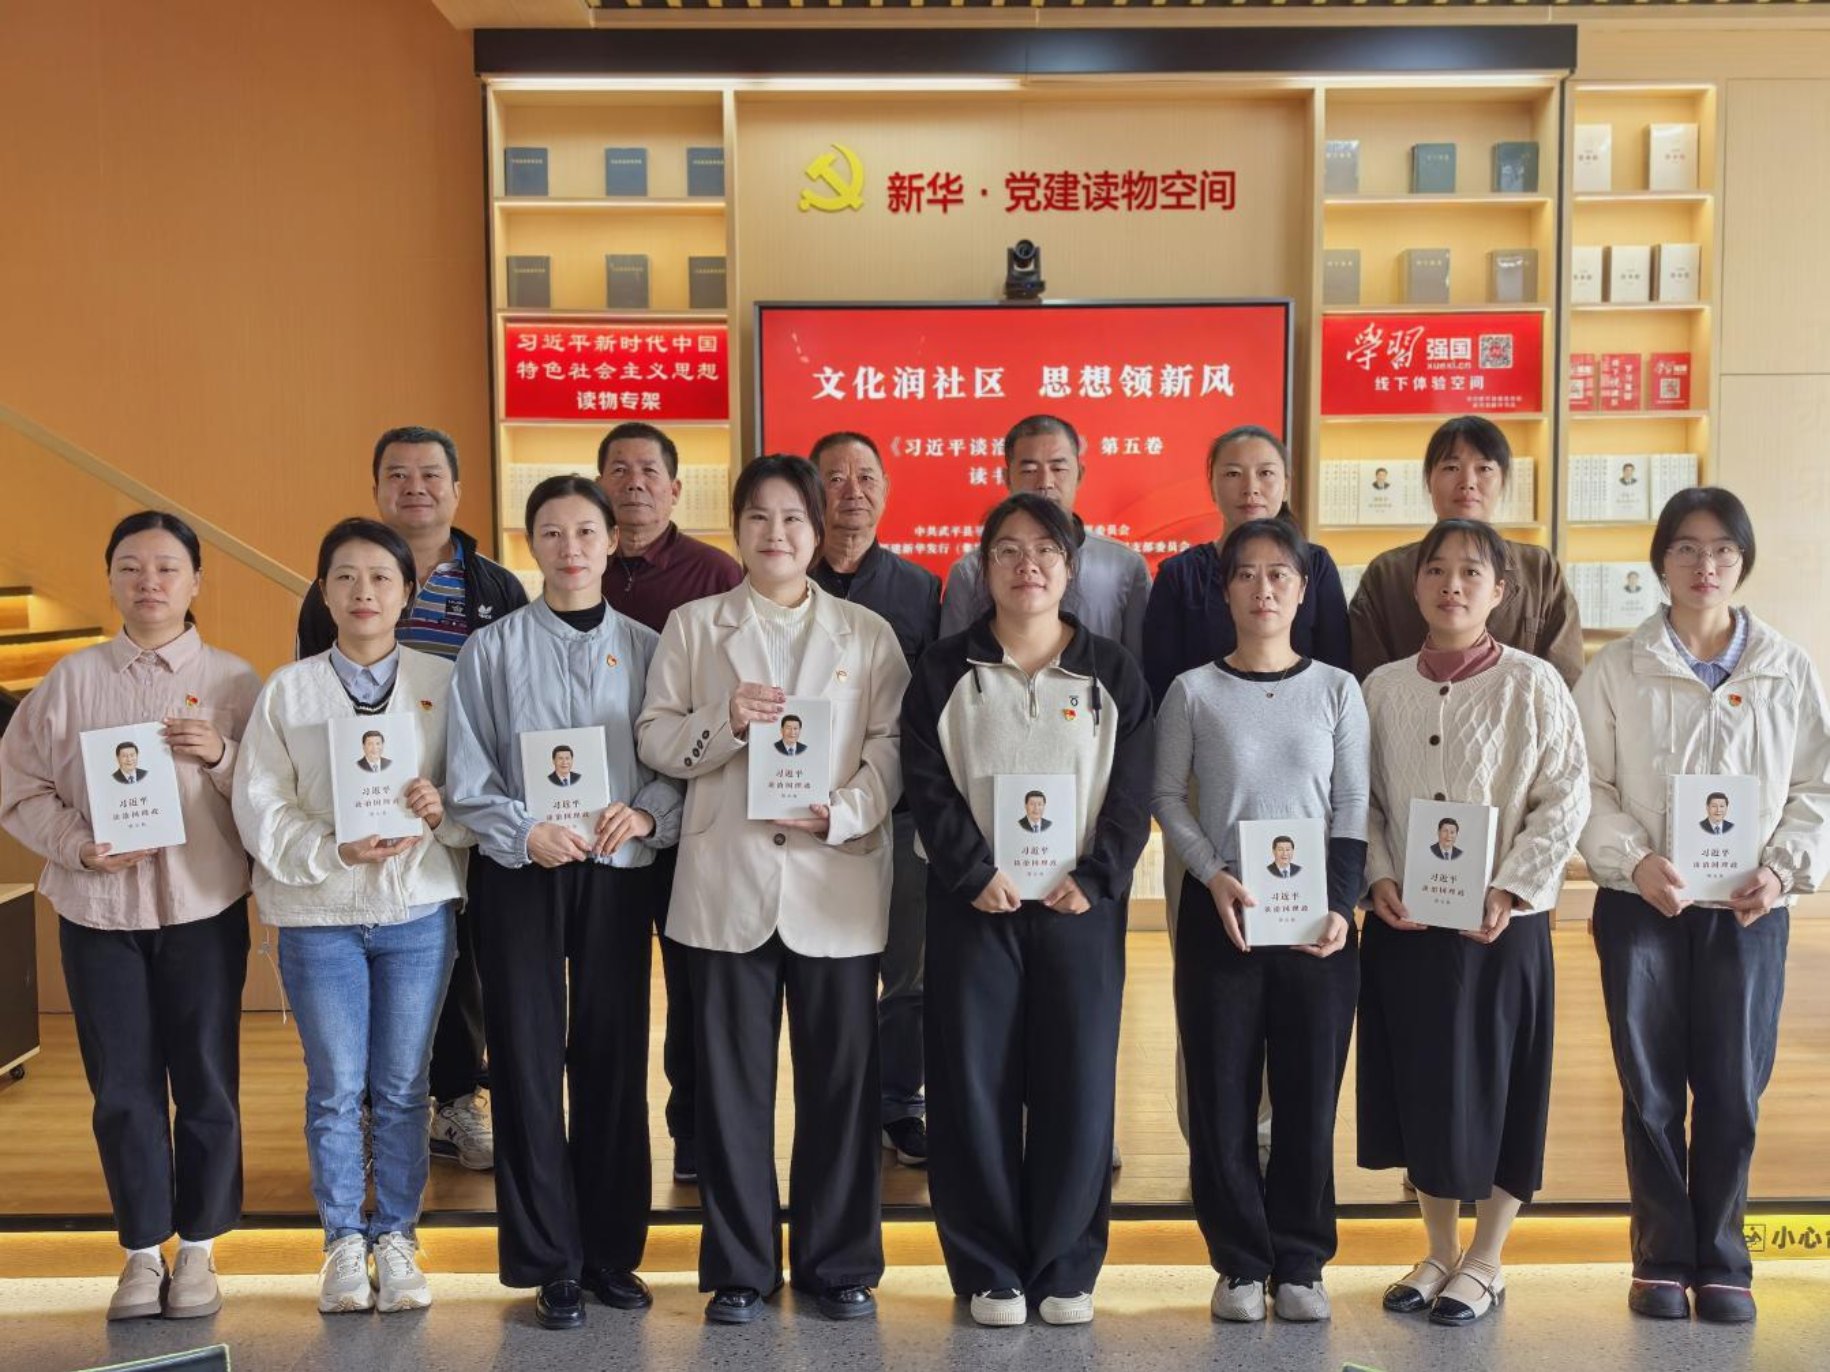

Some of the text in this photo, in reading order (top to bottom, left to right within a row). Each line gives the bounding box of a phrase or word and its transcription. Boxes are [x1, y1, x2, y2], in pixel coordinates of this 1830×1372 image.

[887, 171, 1237, 213] 新华·党建读物空间
[516, 334, 718, 353] 习近平新时代中国
[516, 361, 719, 380] 特色社会主义思想
[812, 363, 1235, 400] 文化润社区 思想领新风
[1374, 375, 1485, 391] 线下体验空间
[576, 391, 662, 411] 读物专架
[1101, 436, 1164, 456] 第五卷
[1771, 1225, 1830, 1250] 小心
